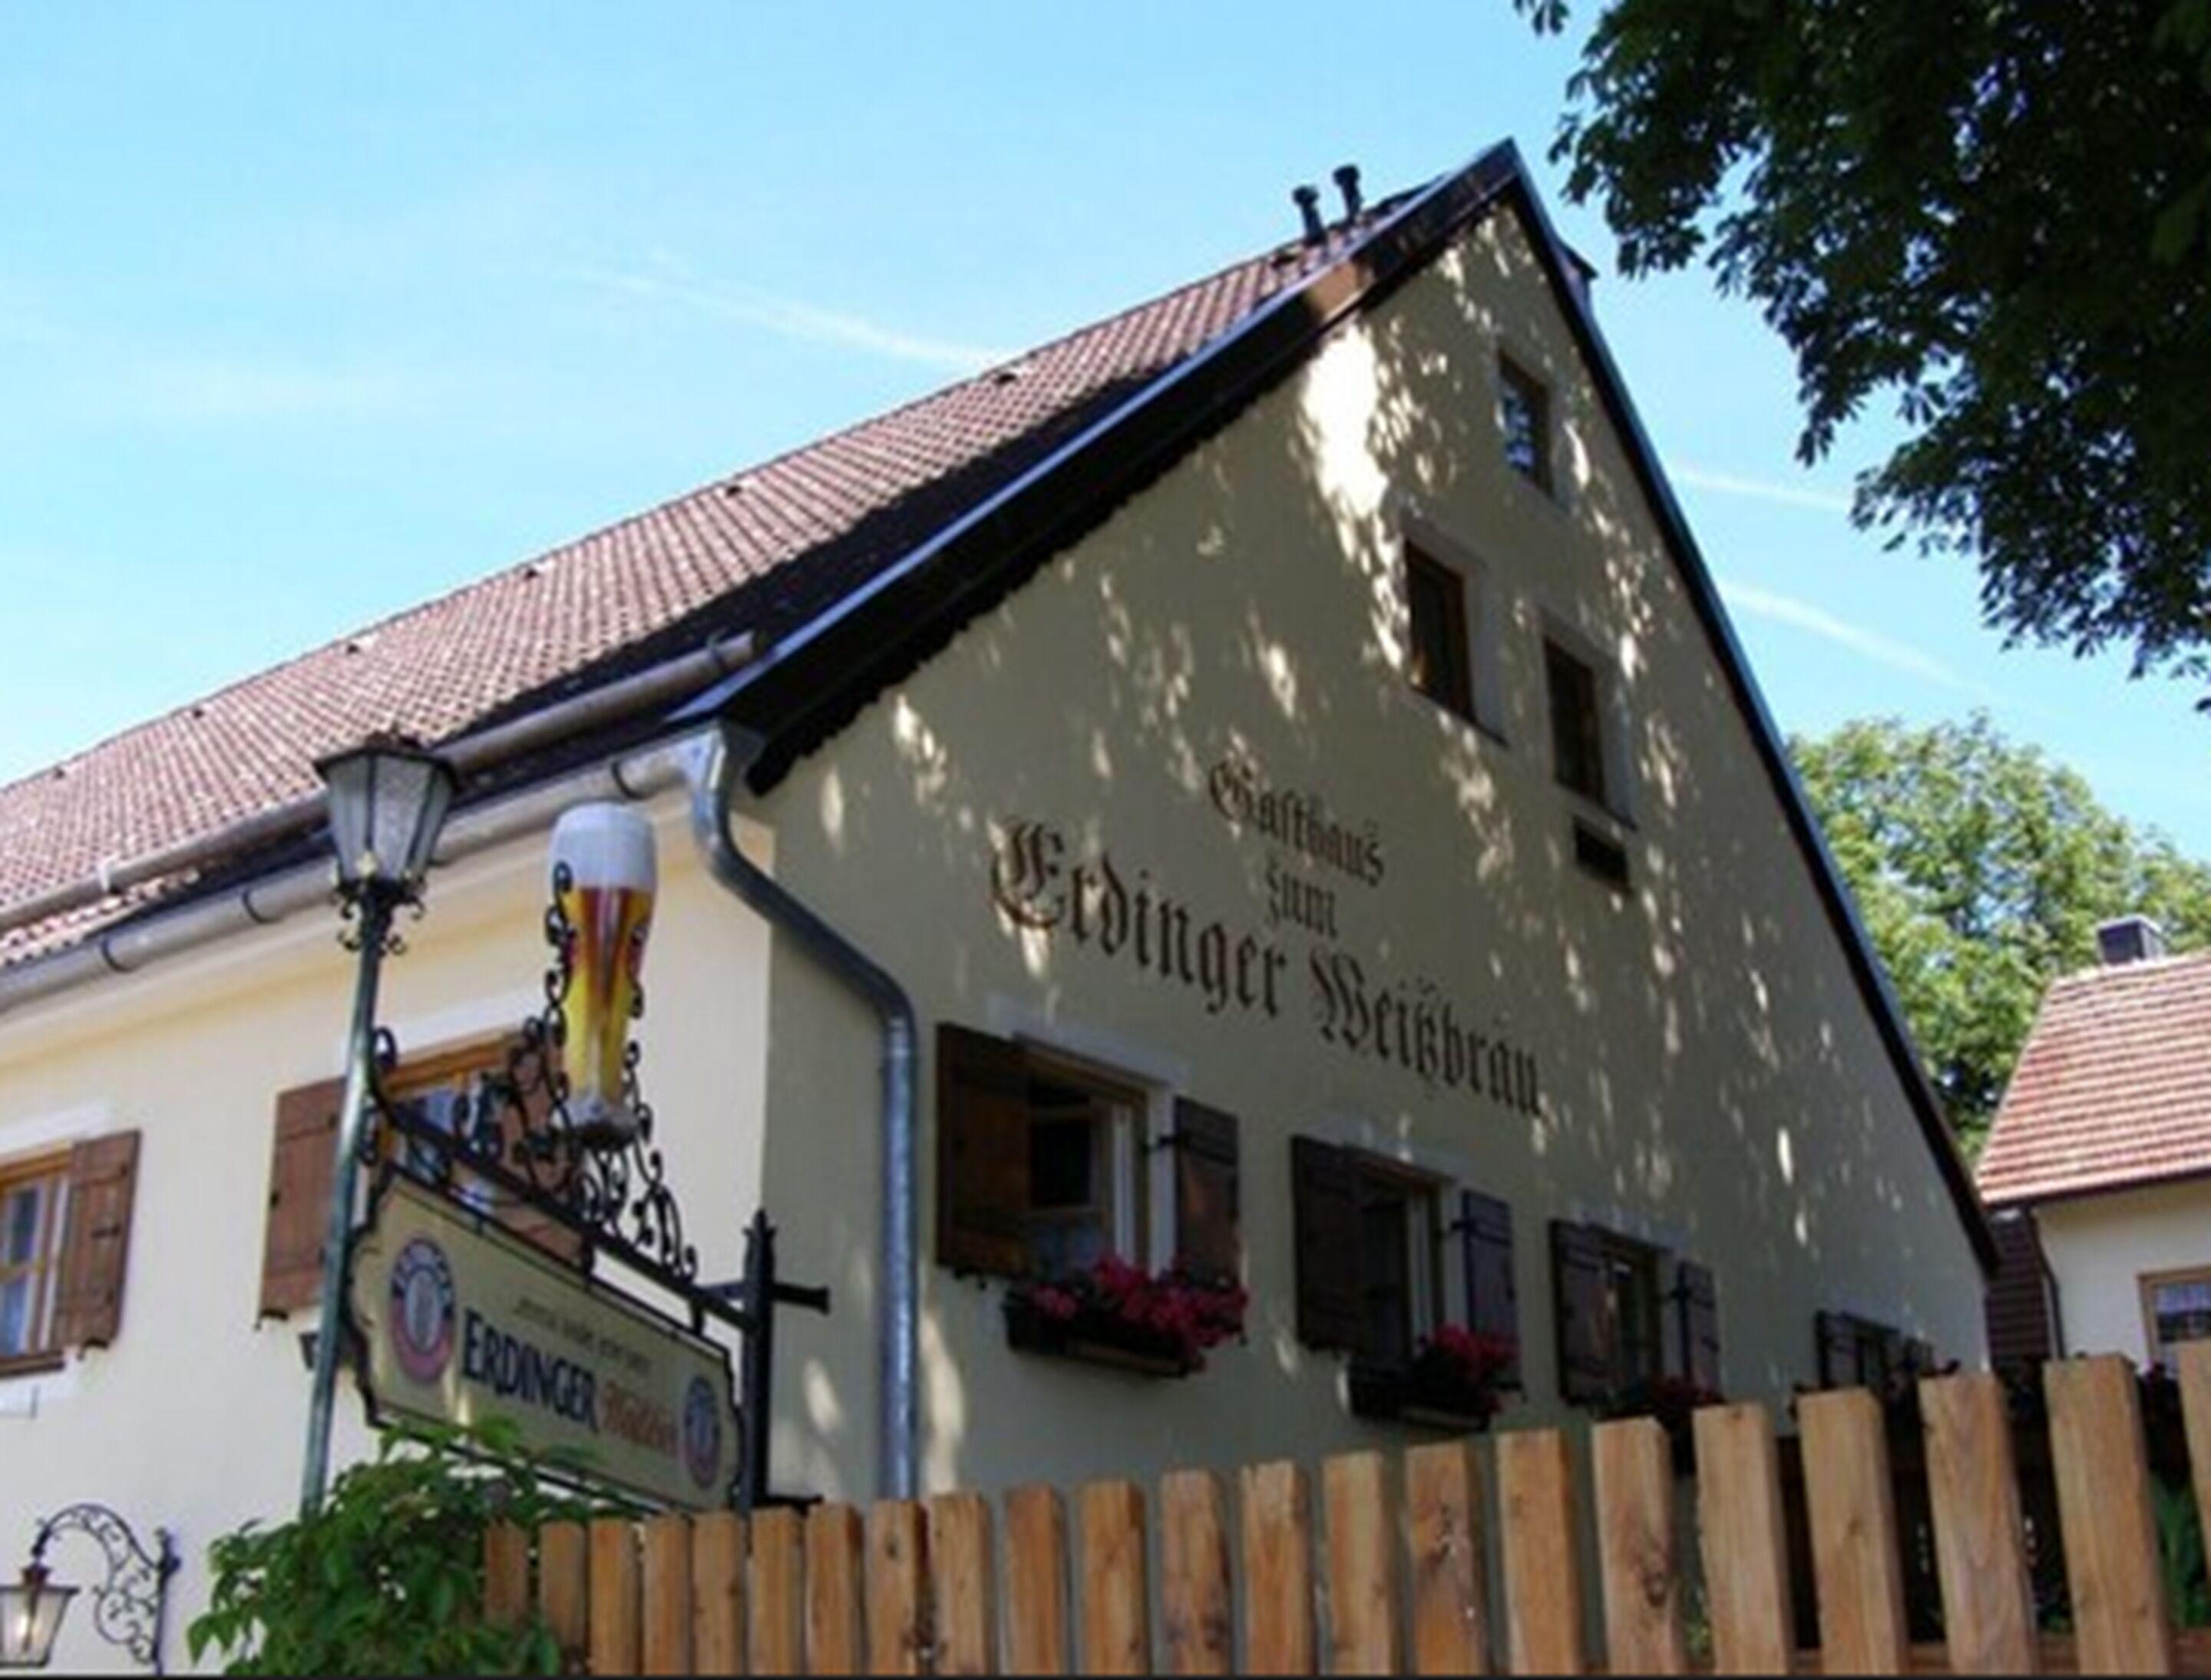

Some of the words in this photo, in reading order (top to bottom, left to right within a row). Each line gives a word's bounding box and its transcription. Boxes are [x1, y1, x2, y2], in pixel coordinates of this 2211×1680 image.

[990, 820, 1287, 1017] Erdinger
[1265, 854, 1338, 939] zum
[464, 1308, 600, 1434] ERDINGER
